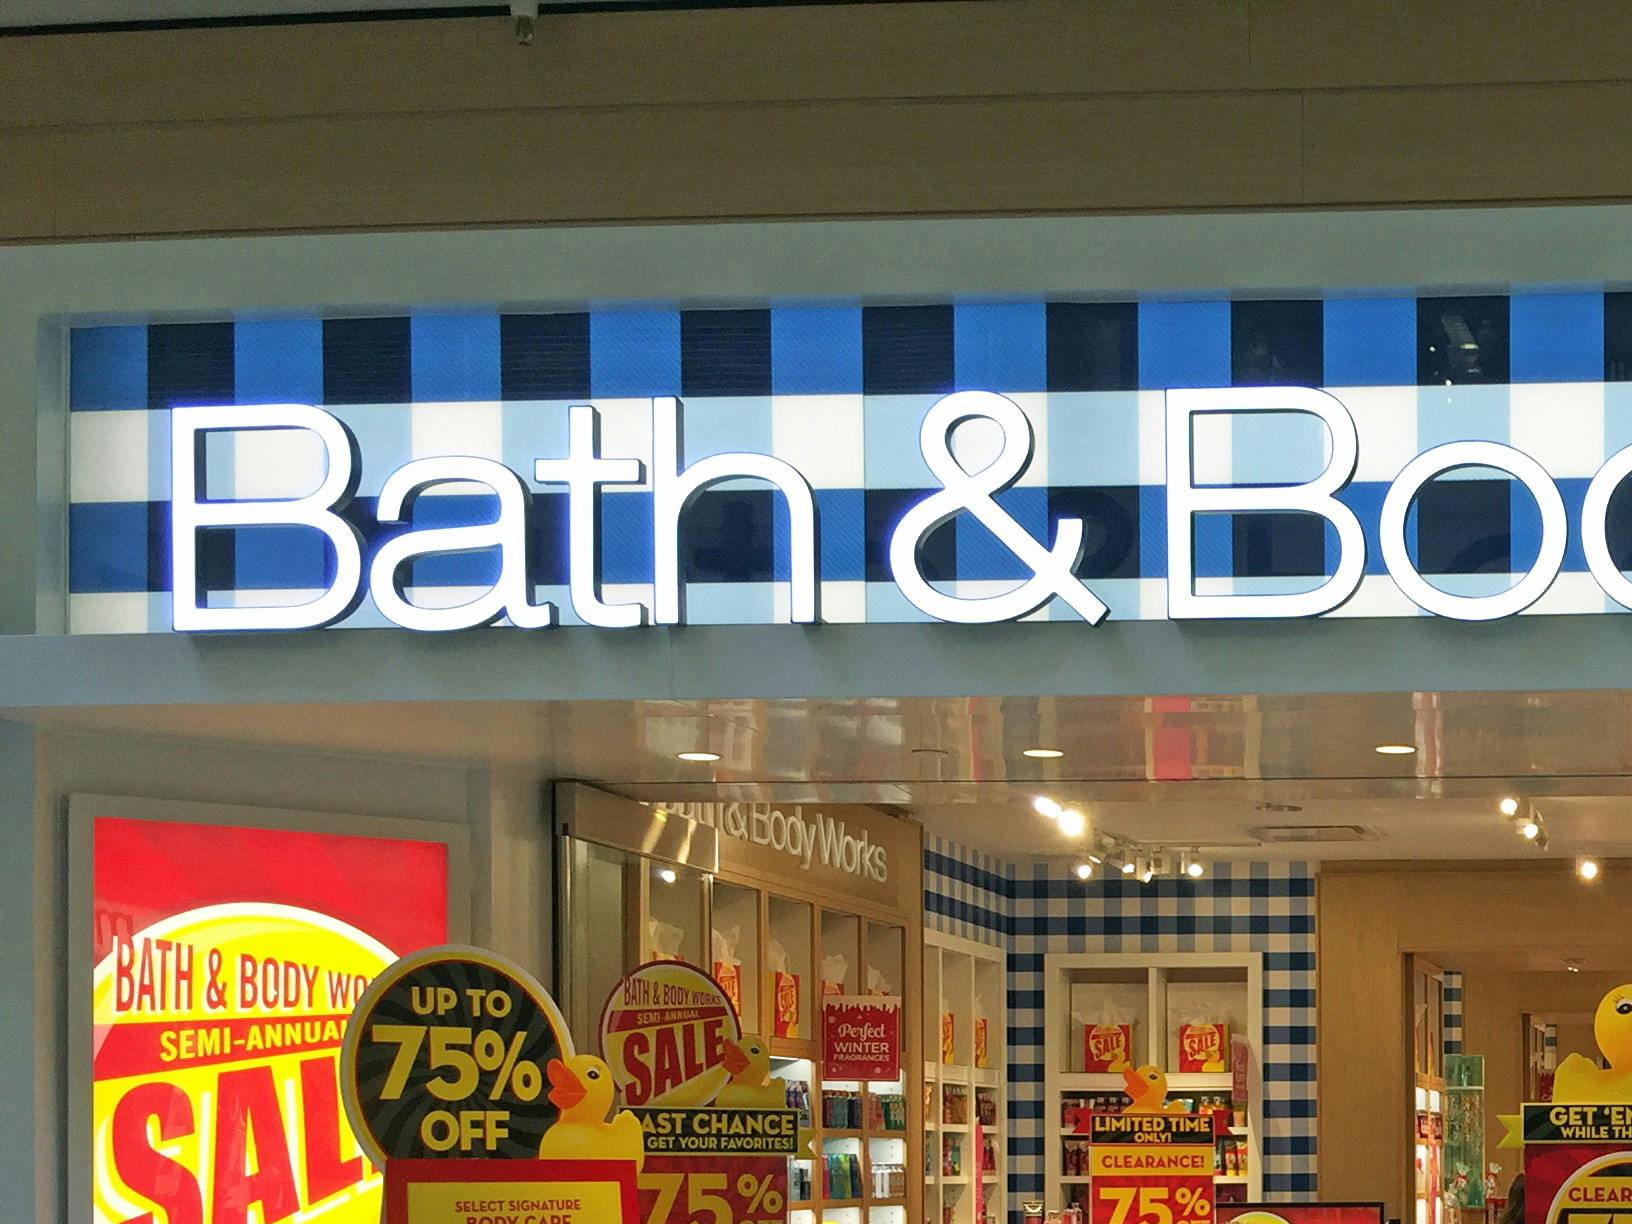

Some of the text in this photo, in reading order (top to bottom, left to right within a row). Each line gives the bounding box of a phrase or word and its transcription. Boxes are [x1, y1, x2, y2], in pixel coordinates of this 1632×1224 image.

[172, 396, 822, 633] Bath
[889, 389, 1111, 627] &
[724, 802, 748, 840] &
[752, 802, 816, 870] Body
[816, 813, 888, 883] Works
[115, 936, 194, 1012] BATH
[206, 947, 228, 1009] &
[240, 953, 320, 1009] BODY
[624, 977, 721, 1006] BATH & BODY WORKS
[411, 987, 457, 1015] UP
[466, 989, 512, 1017] TO
[637, 1010, 700, 1025] SEMI-ANNUAL
[838, 1023, 885, 1041] Perfect
[834, 1042, 890, 1053] WINTER
[1094, 1035, 1122, 1058] SALE
[1189, 1033, 1217, 1057] SALE
[372, 1024, 542, 1101] 75%
[623, 1019, 725, 1106] SALE
[832, 1054, 890, 1062] FRAGRANCES
[641, 1113, 794, 1135] AST CHANCE
[1095, 1117, 1210, 1131] LIMITED TIME
[1550, 1107, 1597, 1125] GET
[421, 1110, 510, 1151] OFF
[1134, 1132, 1171, 1142] ONLY!
[1561, 1126, 1608, 1139] WHILE
[648, 1137, 793, 1149] GET YOUR FAVORITES!
[1102, 1155, 1204, 1168] CLEARANCE!
[455, 1199, 581, 1213] SELECT SIGNATURE
